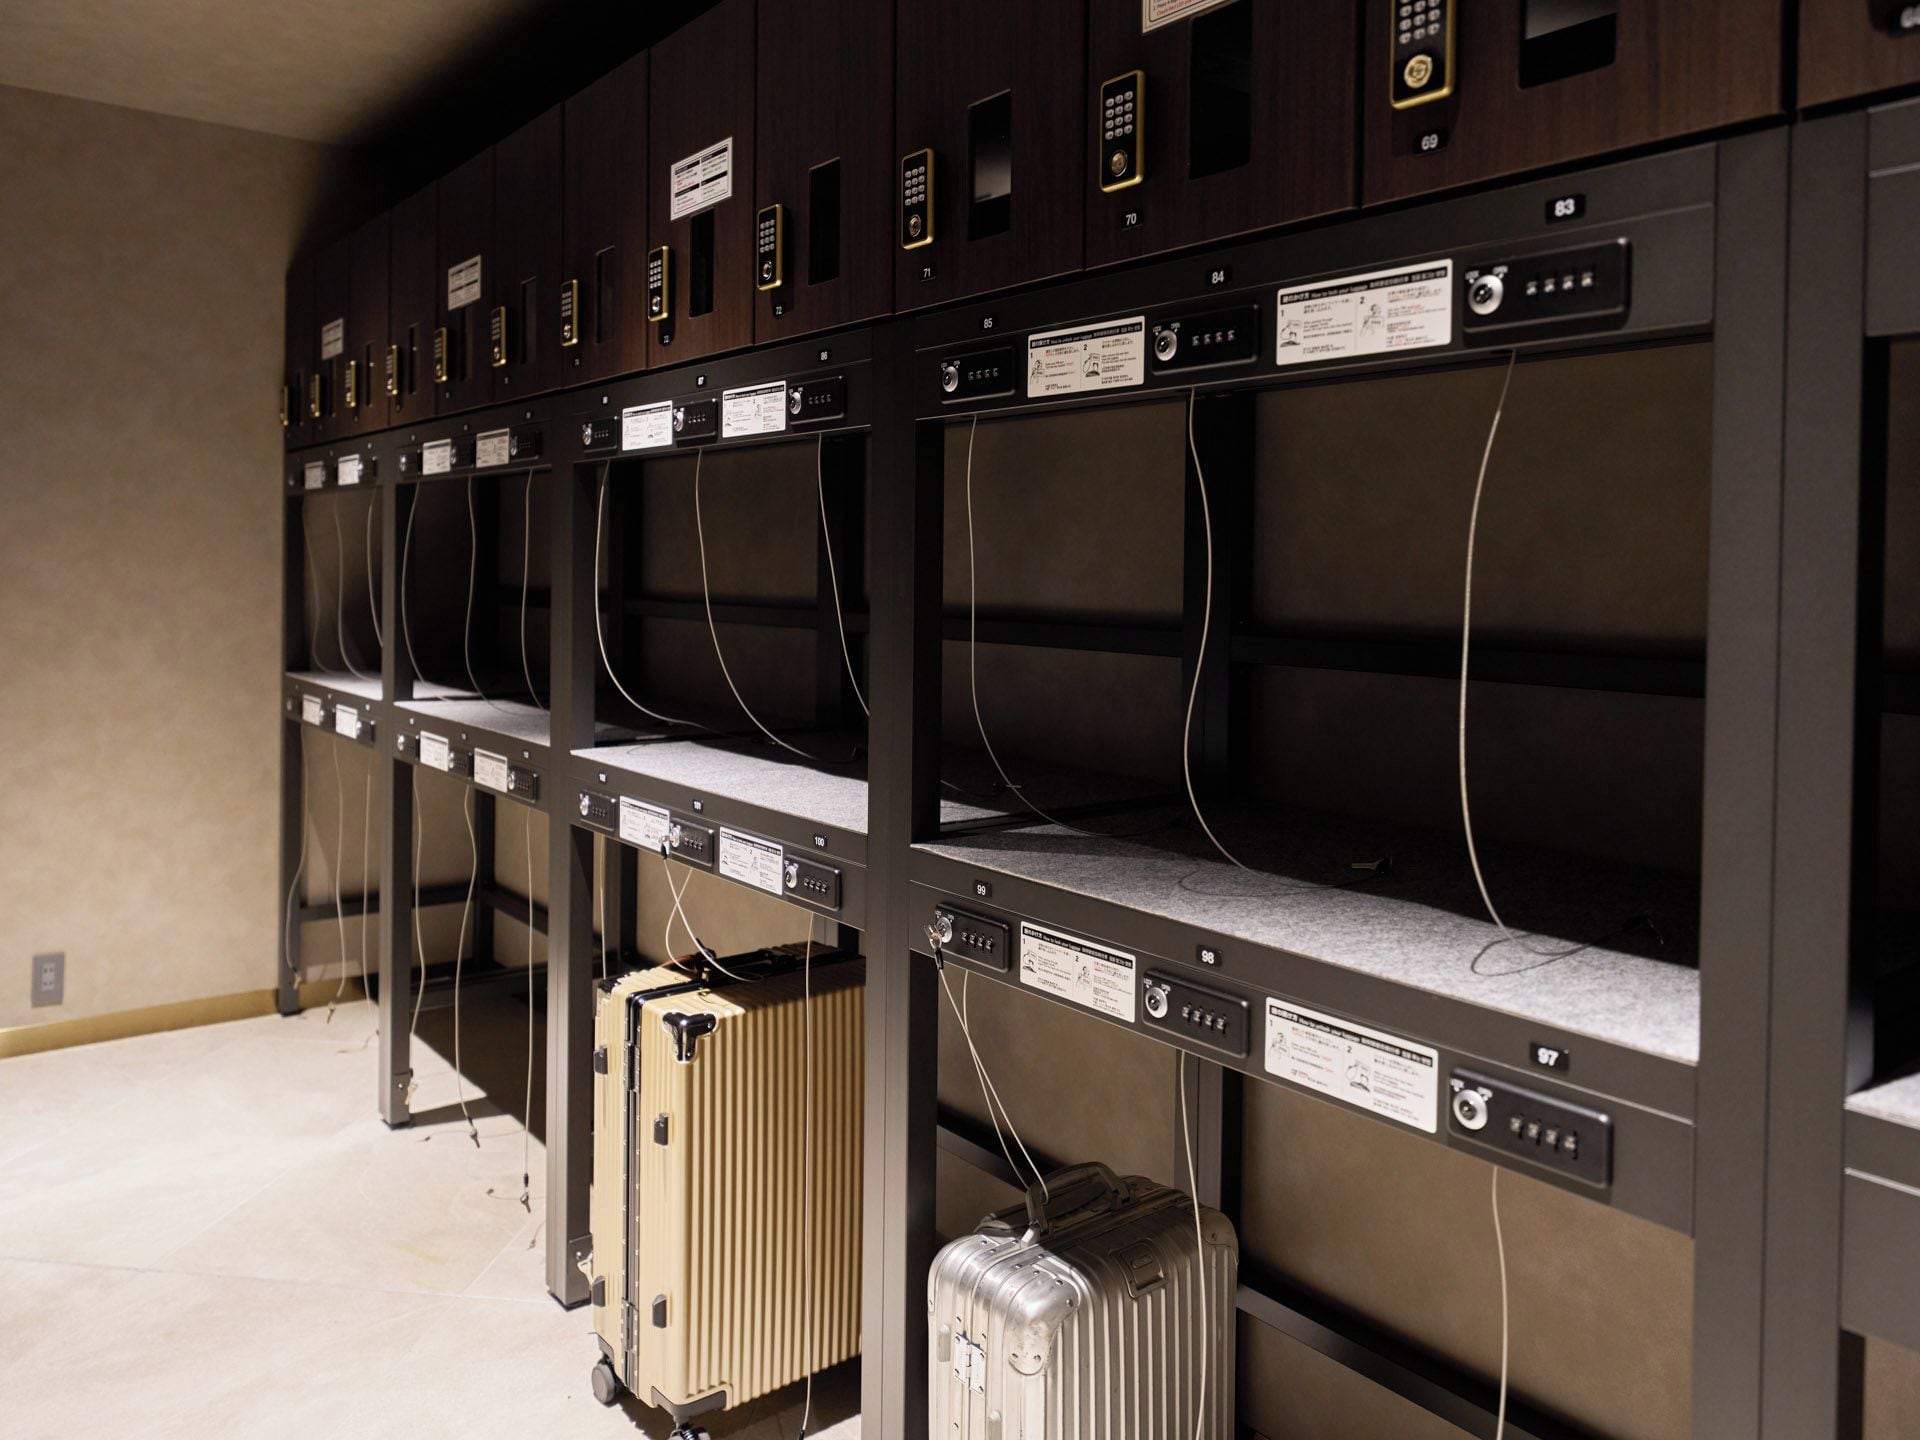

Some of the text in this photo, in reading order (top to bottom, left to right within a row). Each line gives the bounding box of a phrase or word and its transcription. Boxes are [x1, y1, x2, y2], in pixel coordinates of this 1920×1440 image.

[1421, 134, 1439, 151] 69
[1554, 197, 1575, 217] 83
[1125, 212, 1137, 227] 70
[923, 268, 931, 278] 71
[1212, 270, 1224, 284] 84
[983, 318, 993, 329] 85
[814, 836, 825, 846] 100
[976, 884, 986, 896] 99
[1201, 950, 1215, 964] 98
[1537, 1048, 1559, 1066] 97
